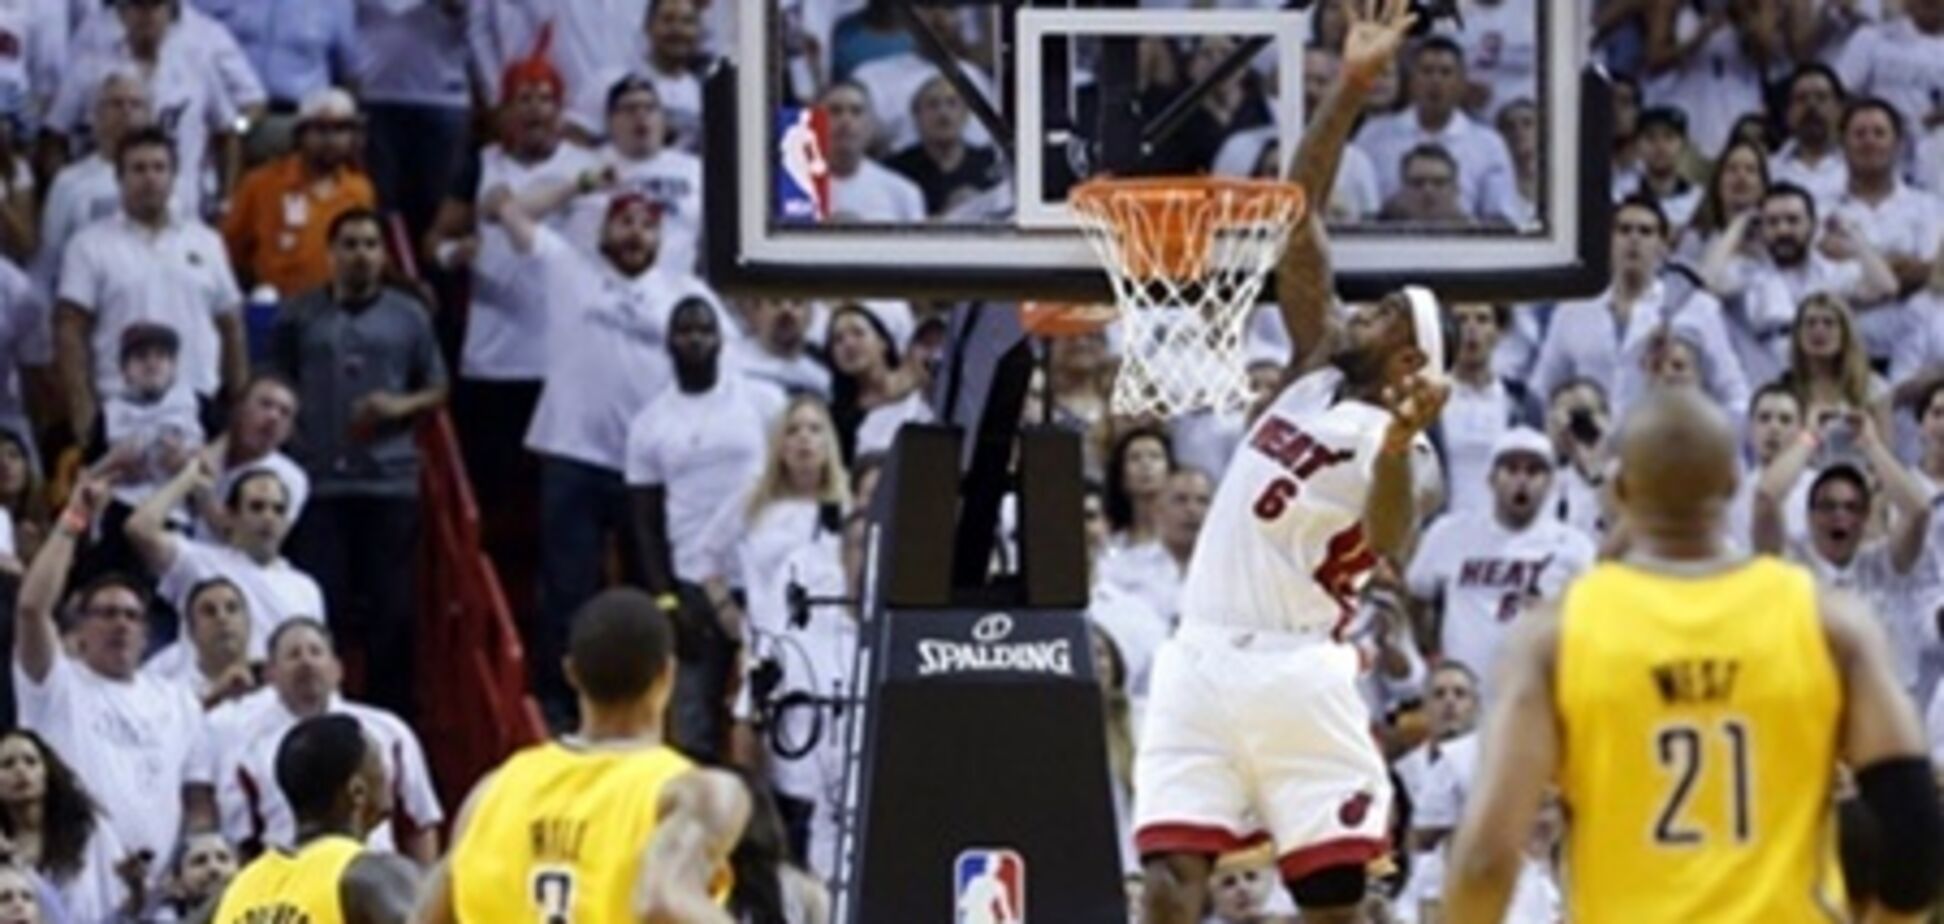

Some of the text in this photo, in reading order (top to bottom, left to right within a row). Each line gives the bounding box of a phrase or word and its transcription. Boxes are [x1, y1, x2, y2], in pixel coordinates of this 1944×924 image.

[1249, 415, 1355, 480] HEAT
[1253, 478, 1298, 521] 6
[1459, 553, 1554, 597] HEAT
[918, 638, 1073, 676] SPALDING
[1651, 660, 1741, 706] WEST
[1654, 718, 1752, 845] 21
